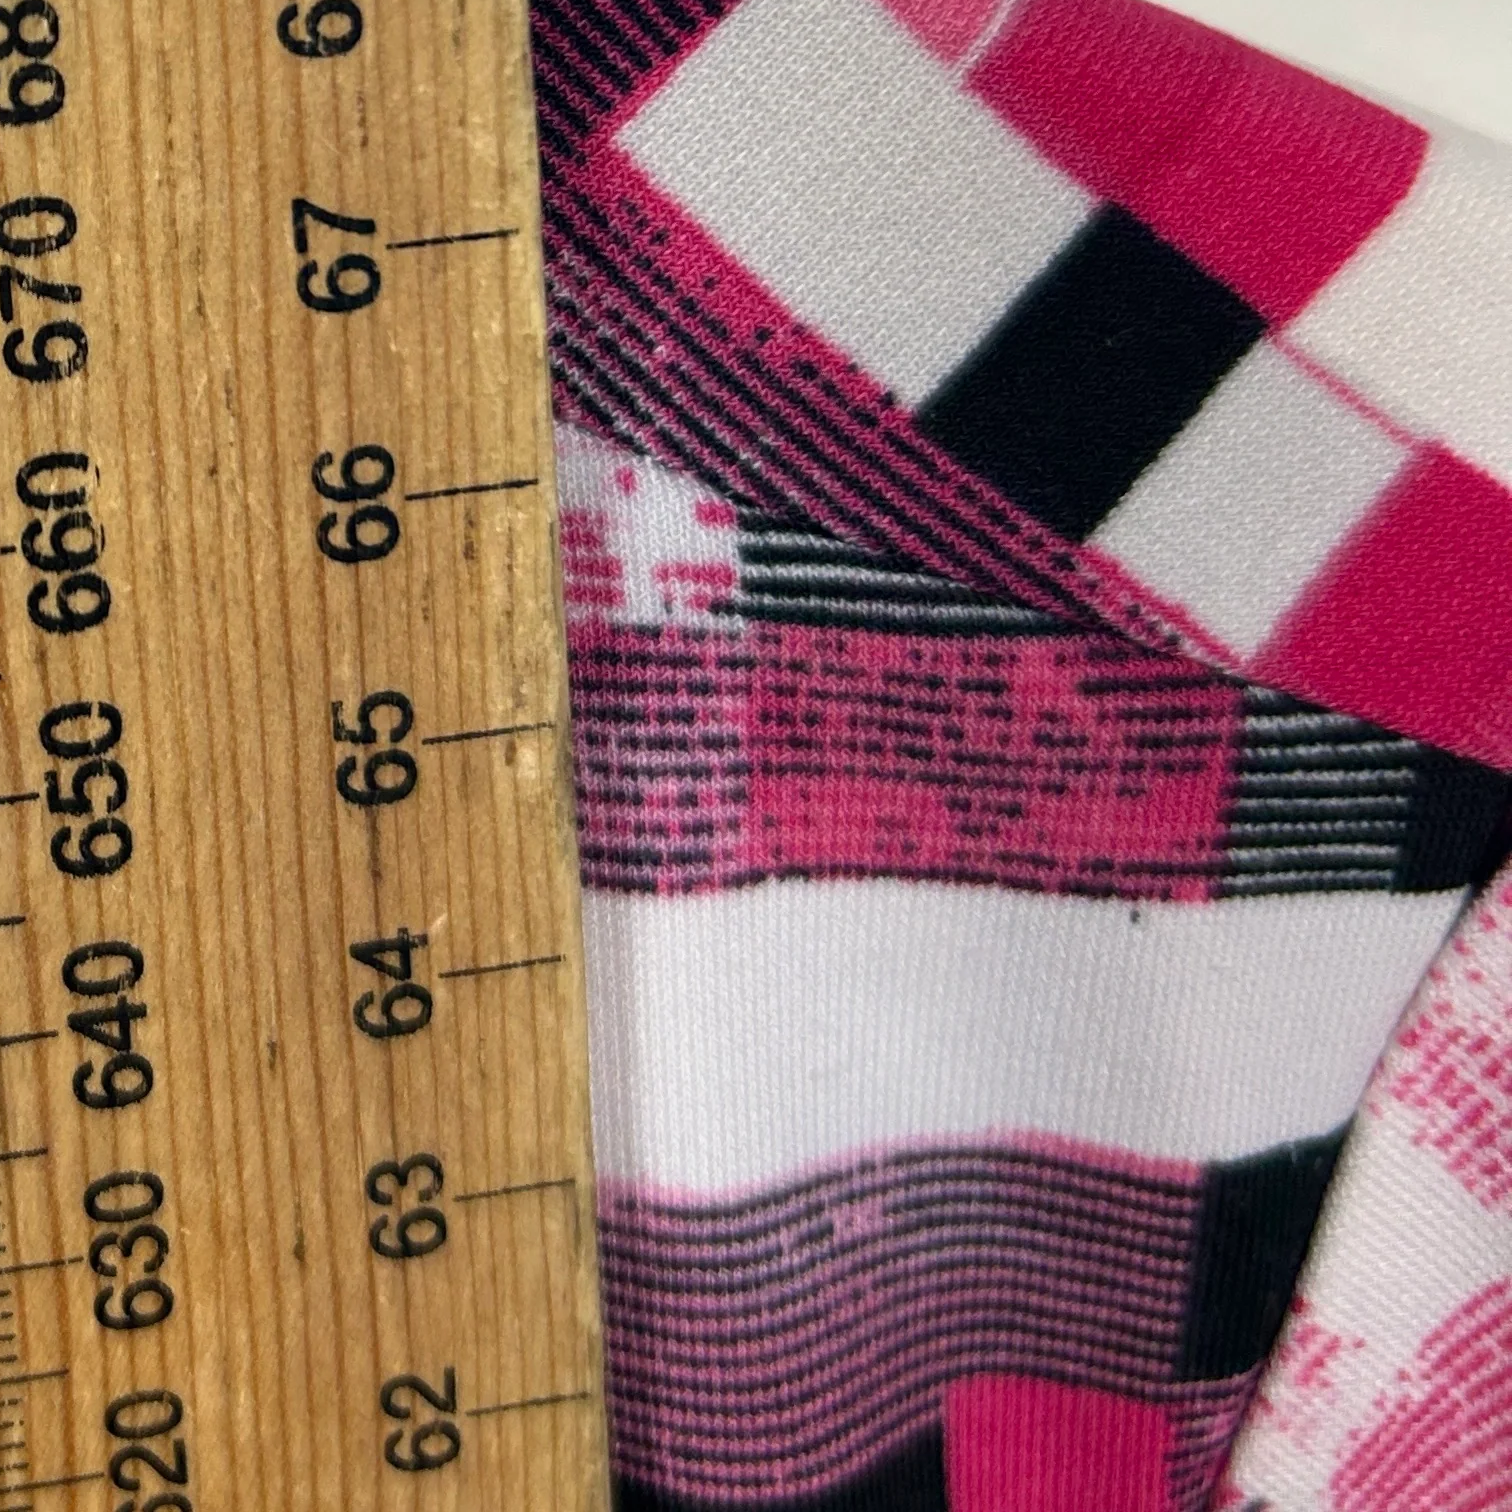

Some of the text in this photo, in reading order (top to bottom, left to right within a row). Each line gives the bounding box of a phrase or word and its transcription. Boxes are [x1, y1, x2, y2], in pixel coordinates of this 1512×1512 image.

[292, 197, 381, 315] 67
[16, 450, 111, 634] 660
[311, 443, 400, 565] 66
[38, 700, 133, 877] 650
[331, 689, 418, 807] 65
[61, 940, 154, 1110] 640
[350, 926, 433, 1040] 64
[84, 1170, 176, 1331] 630
[365, 1151, 447, 1258] 63
[380, 1366, 462, 1472] 62
